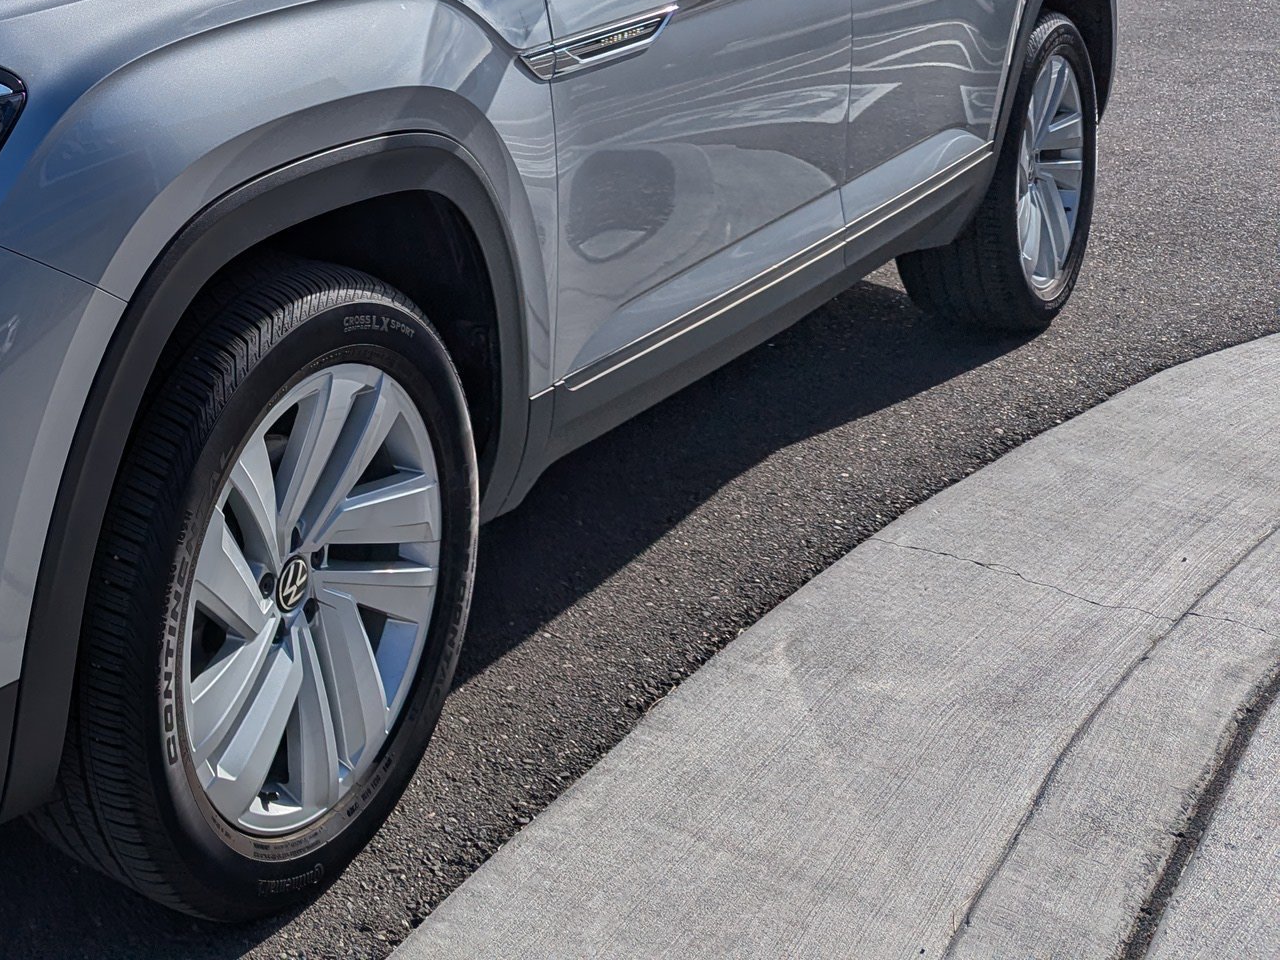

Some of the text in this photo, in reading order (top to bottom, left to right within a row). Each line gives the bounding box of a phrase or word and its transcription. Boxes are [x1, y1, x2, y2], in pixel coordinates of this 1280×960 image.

[343, 315, 371, 327] CROSS
[390, 319, 416, 338] SPORT
[163, 444, 235, 765] CONTINENTAL
